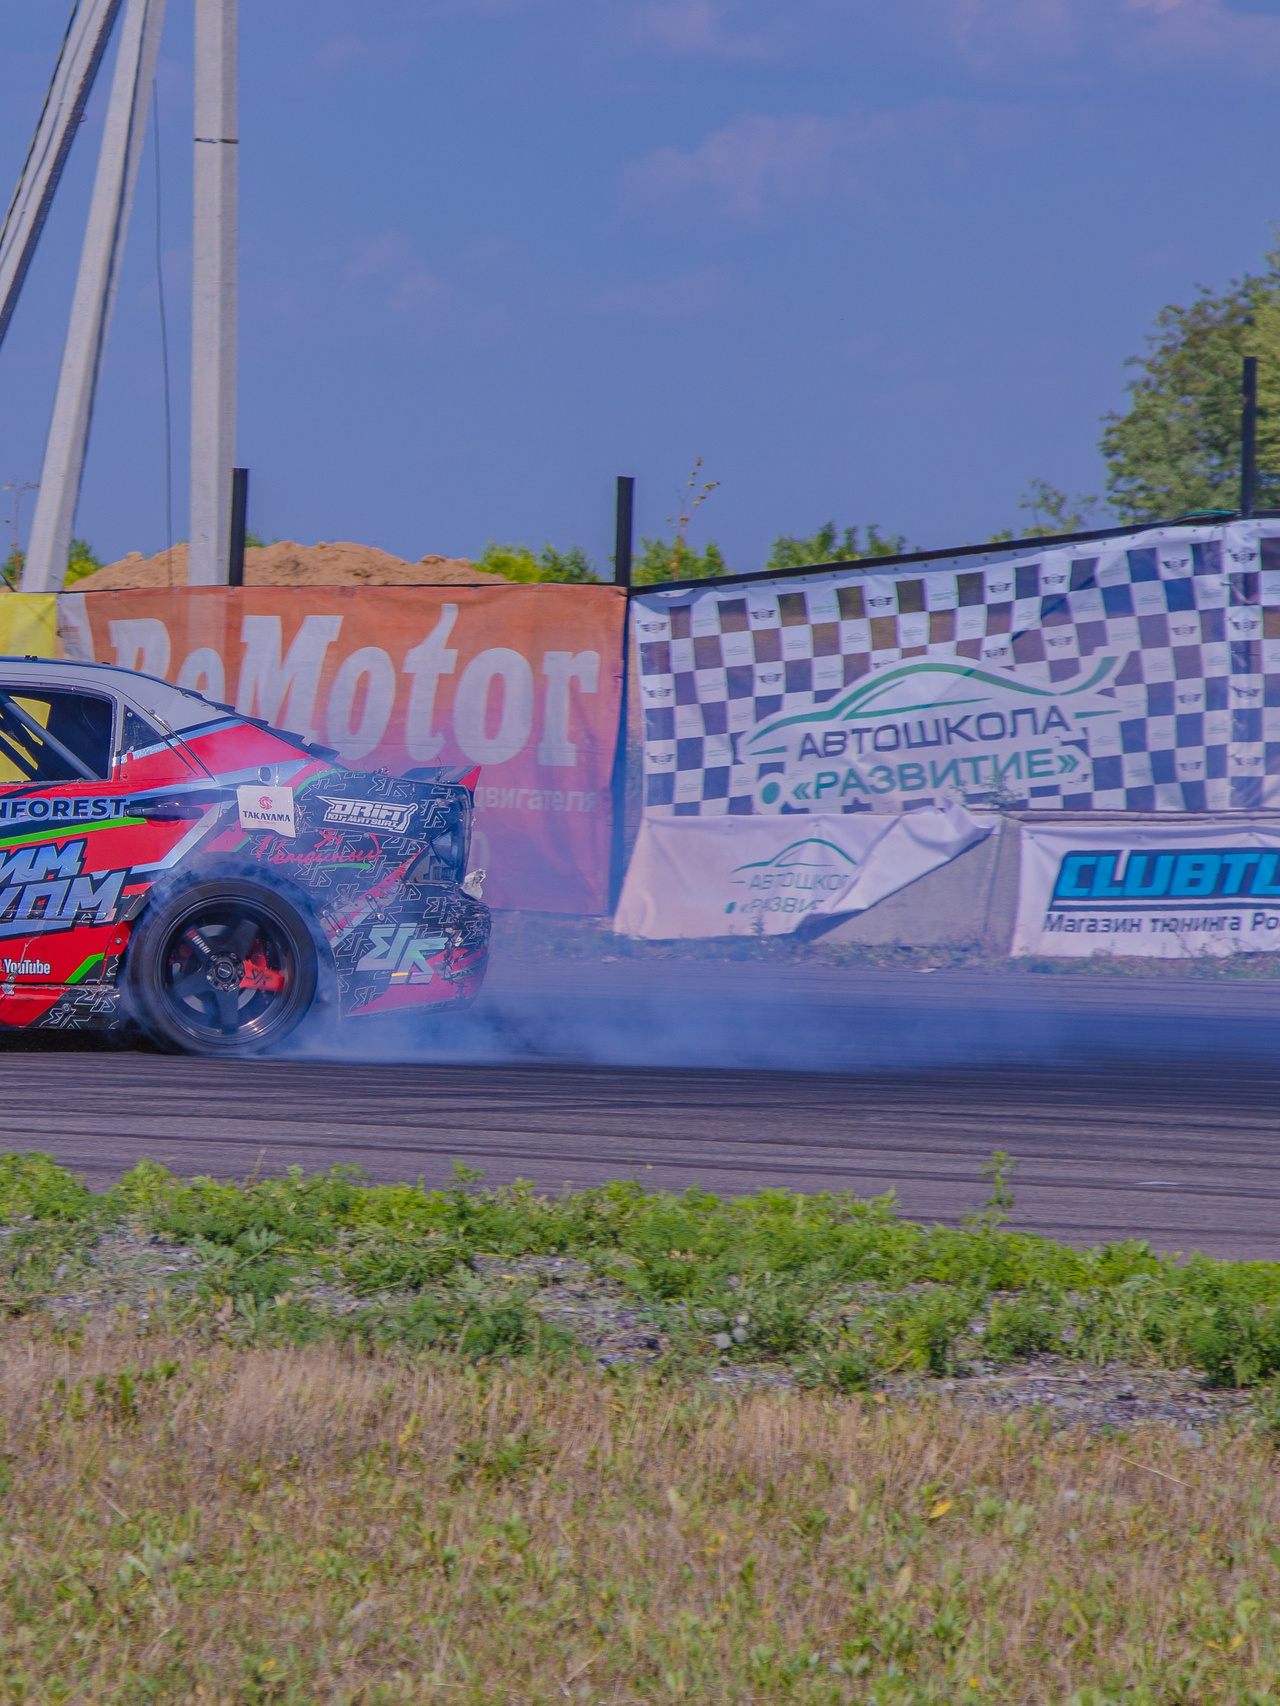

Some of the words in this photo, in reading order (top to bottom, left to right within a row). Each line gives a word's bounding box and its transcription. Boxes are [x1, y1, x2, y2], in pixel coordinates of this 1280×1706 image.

[798, 705, 1070, 761] АВТОШКОЛА
[792, 748, 1080, 800] «РАЗВИТИЕ»
[242, 810, 291, 823] TAKAYAMA
[1042, 914, 1142, 933] Магазин
[1150, 915, 1241, 933] тюнинга
[3, 958, 51, 975] YouTube
